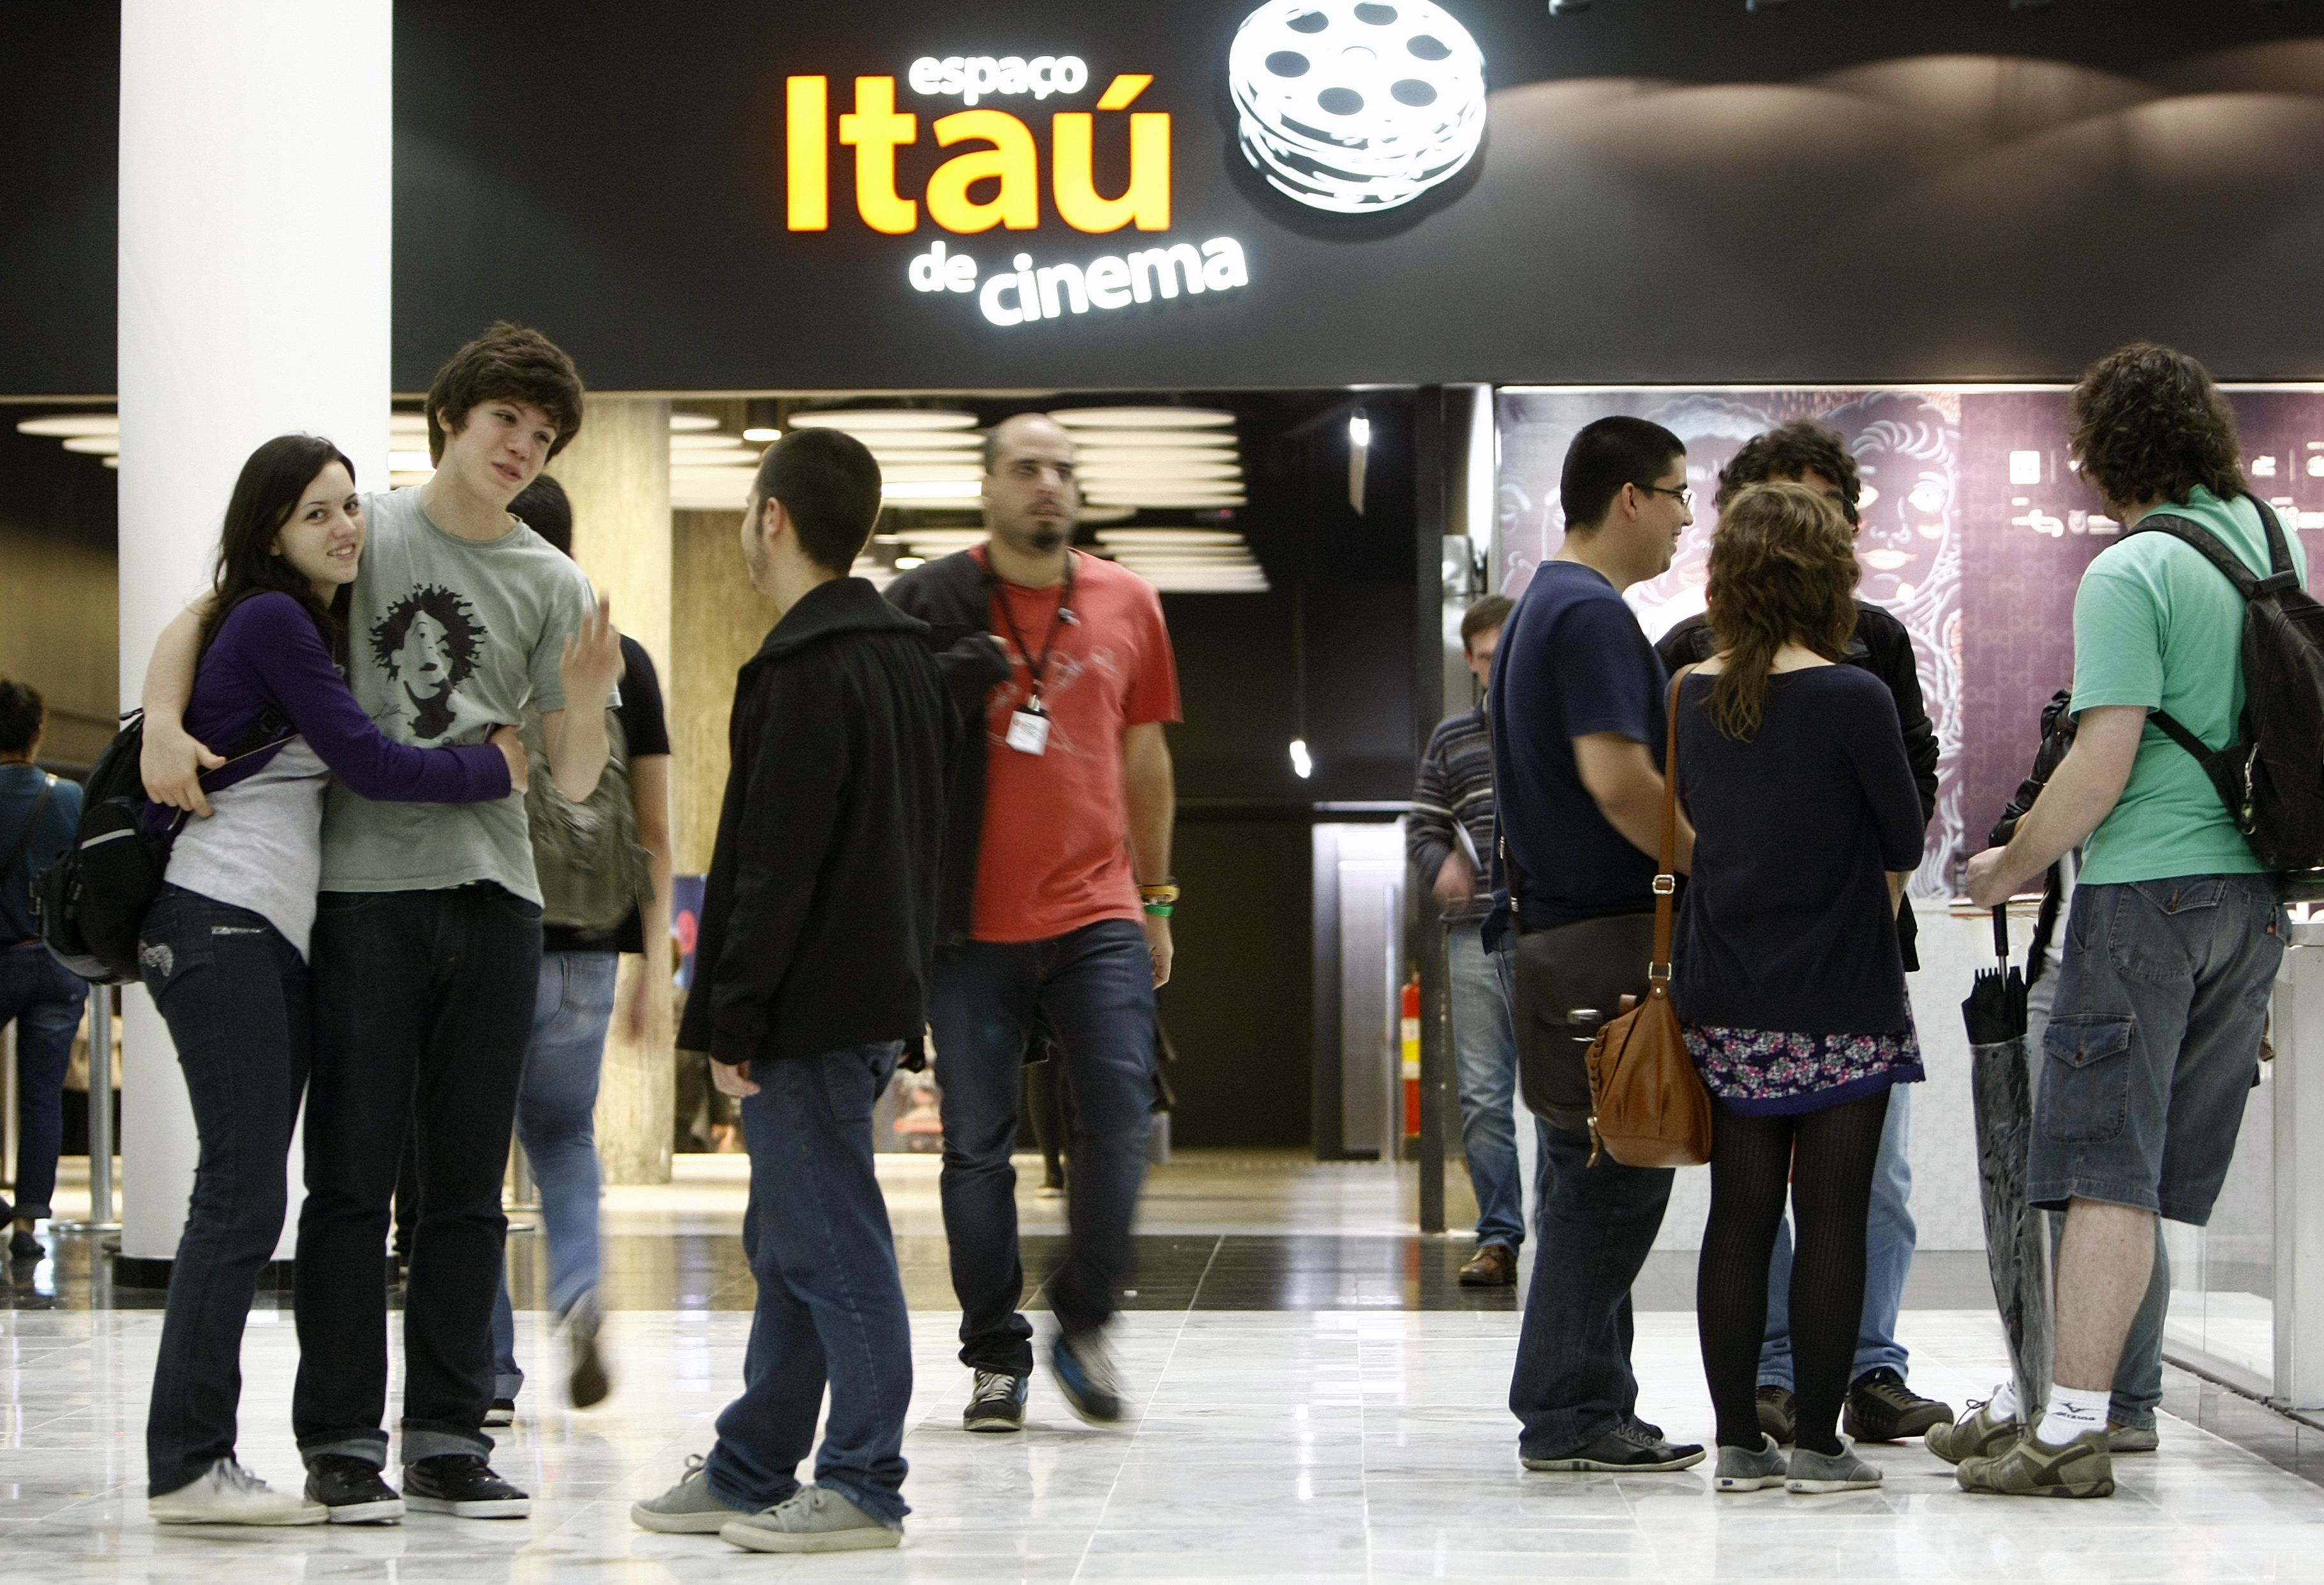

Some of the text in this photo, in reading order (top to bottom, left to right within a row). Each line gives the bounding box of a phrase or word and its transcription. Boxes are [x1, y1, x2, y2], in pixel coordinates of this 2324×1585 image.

[908, 55, 1088, 106] espaço
[786, 73, 1172, 234] Itaú
[908, 236, 1249, 327] de cinema
